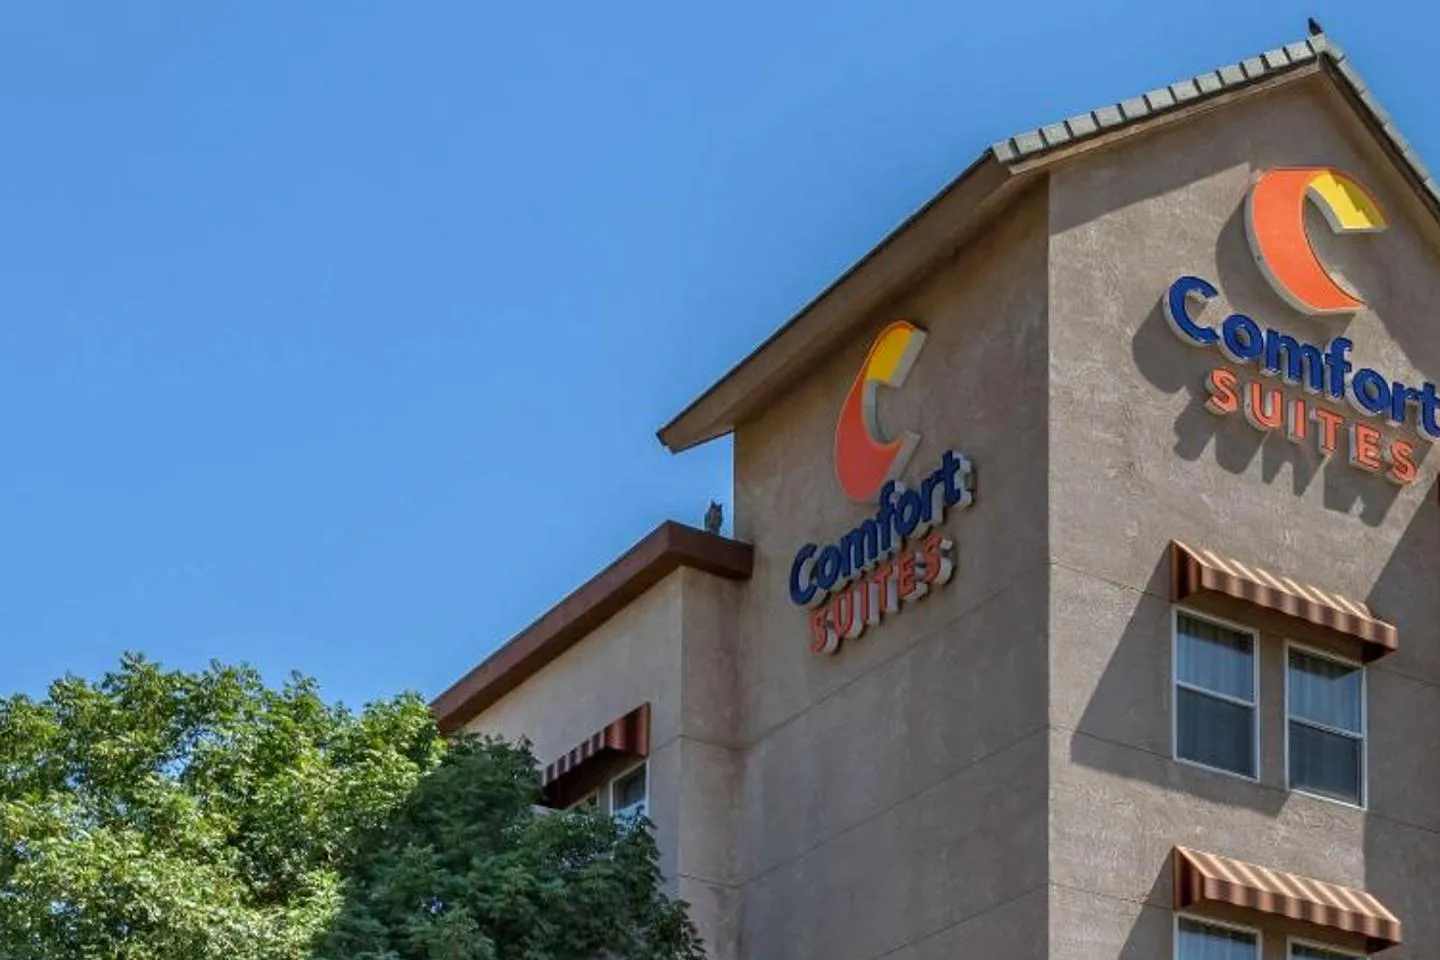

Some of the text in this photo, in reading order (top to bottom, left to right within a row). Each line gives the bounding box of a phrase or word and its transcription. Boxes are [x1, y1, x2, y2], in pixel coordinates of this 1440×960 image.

[1207, 367, 1418, 484] SUITES
[789, 450, 971, 606] Comfort
[811, 533, 955, 655] SUITES
